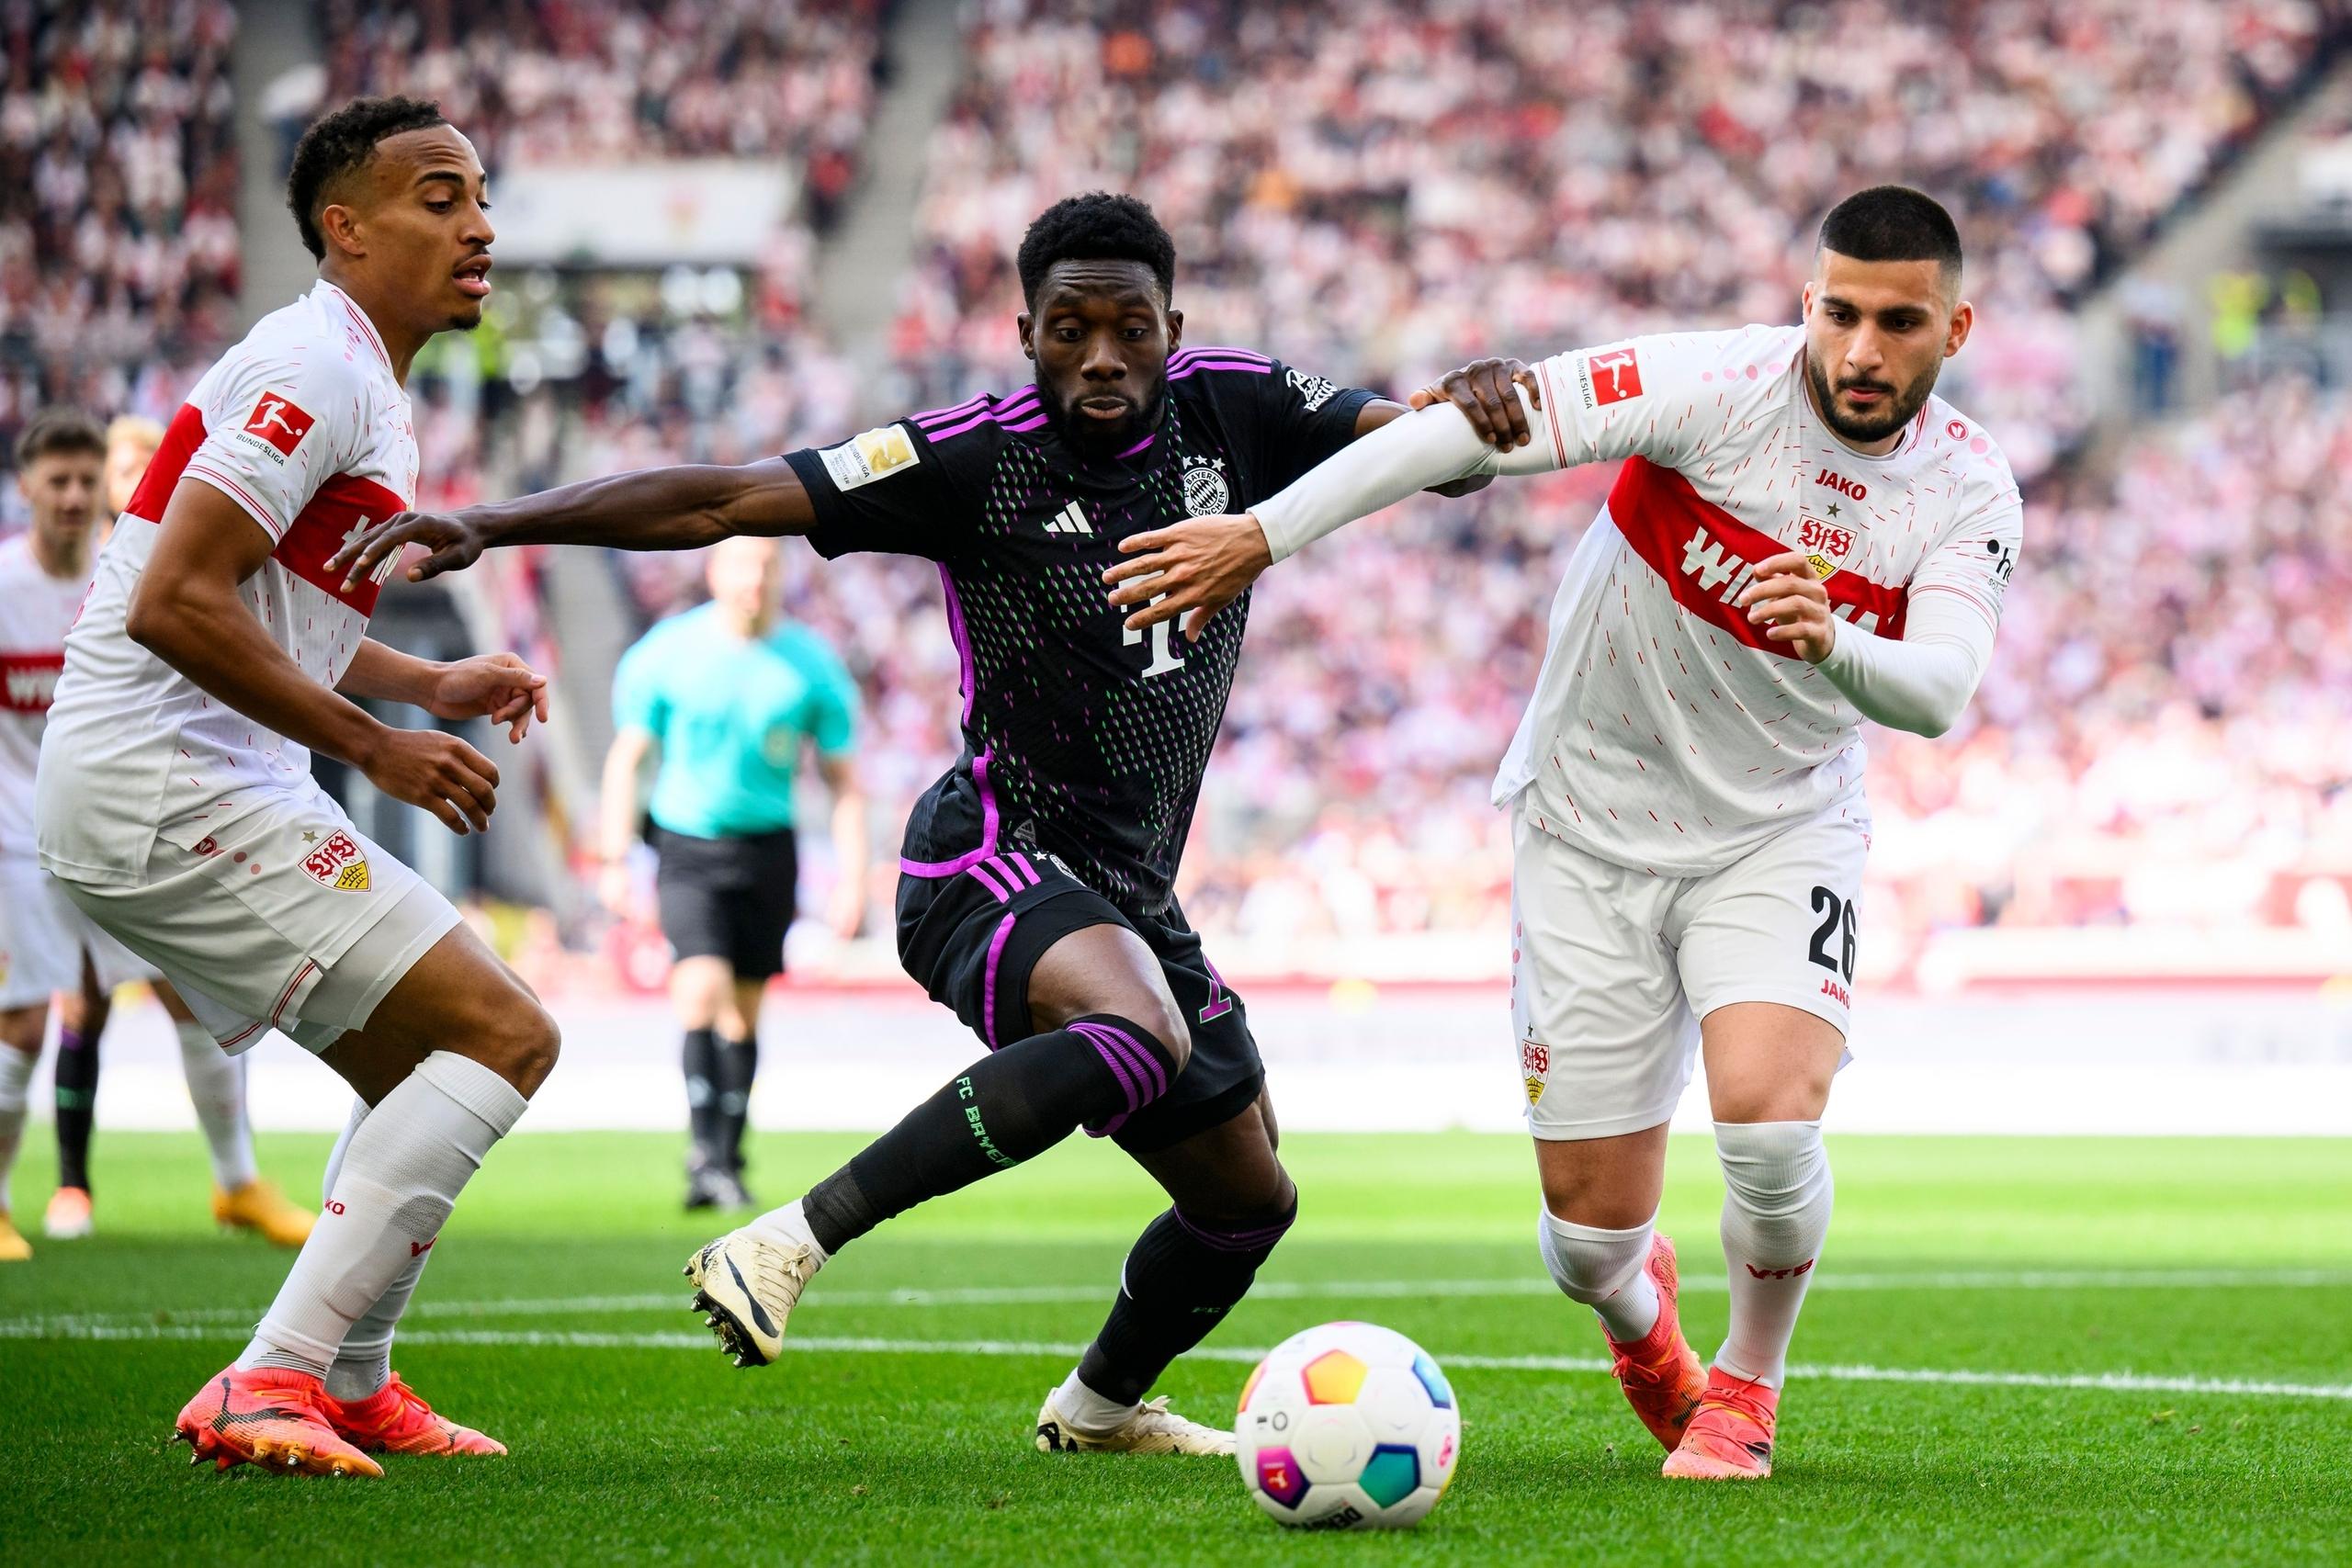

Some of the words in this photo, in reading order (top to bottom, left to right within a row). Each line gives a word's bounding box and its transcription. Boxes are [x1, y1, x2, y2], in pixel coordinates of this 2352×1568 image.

[1577, 357, 1592, 410] BUNDESLIGA
[236, 434, 285, 467] BUNDESLIGA
[1186, 471, 1219, 485] BAYERN
[1815, 468, 1867, 502] JAKO
[1808, 886, 1857, 987] 26
[956, 1077, 974, 1100] FC
